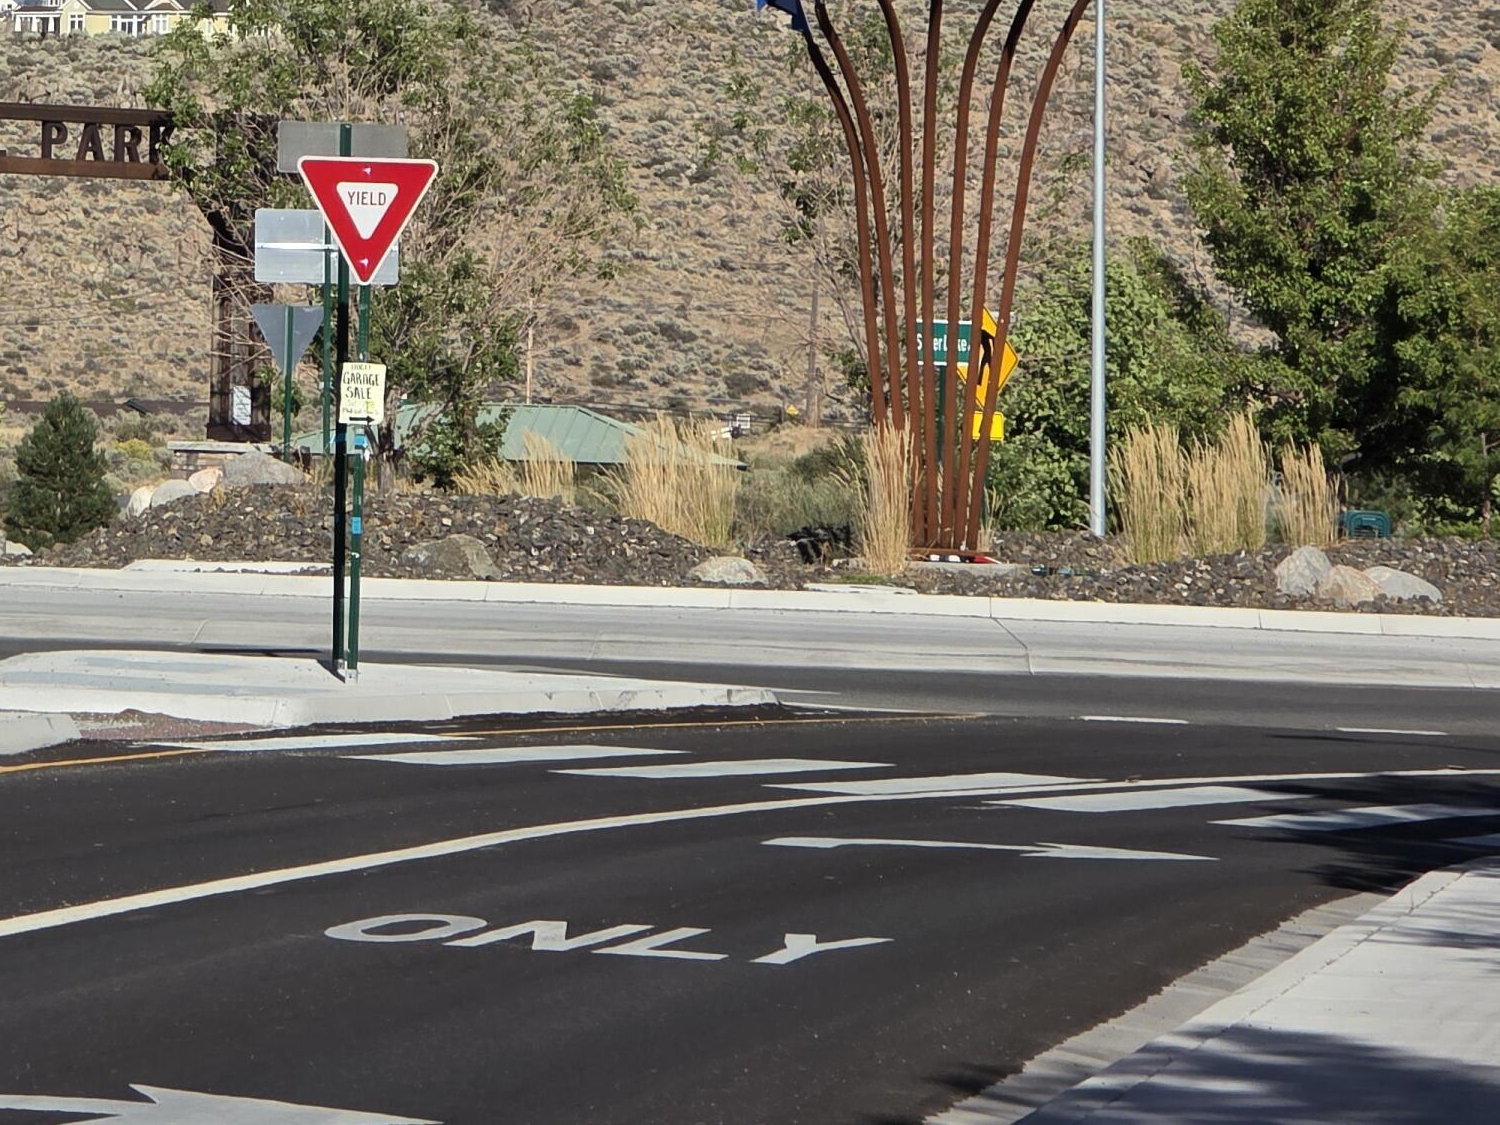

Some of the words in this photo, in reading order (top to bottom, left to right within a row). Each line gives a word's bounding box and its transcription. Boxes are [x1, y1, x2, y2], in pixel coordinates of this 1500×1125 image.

[41, 120, 176, 166] PARK
[347, 191, 387, 206] YIELD
[343, 371, 380, 386] GARAGE
[345, 386, 372, 400] SALE
[324, 913, 895, 965] ONLY
